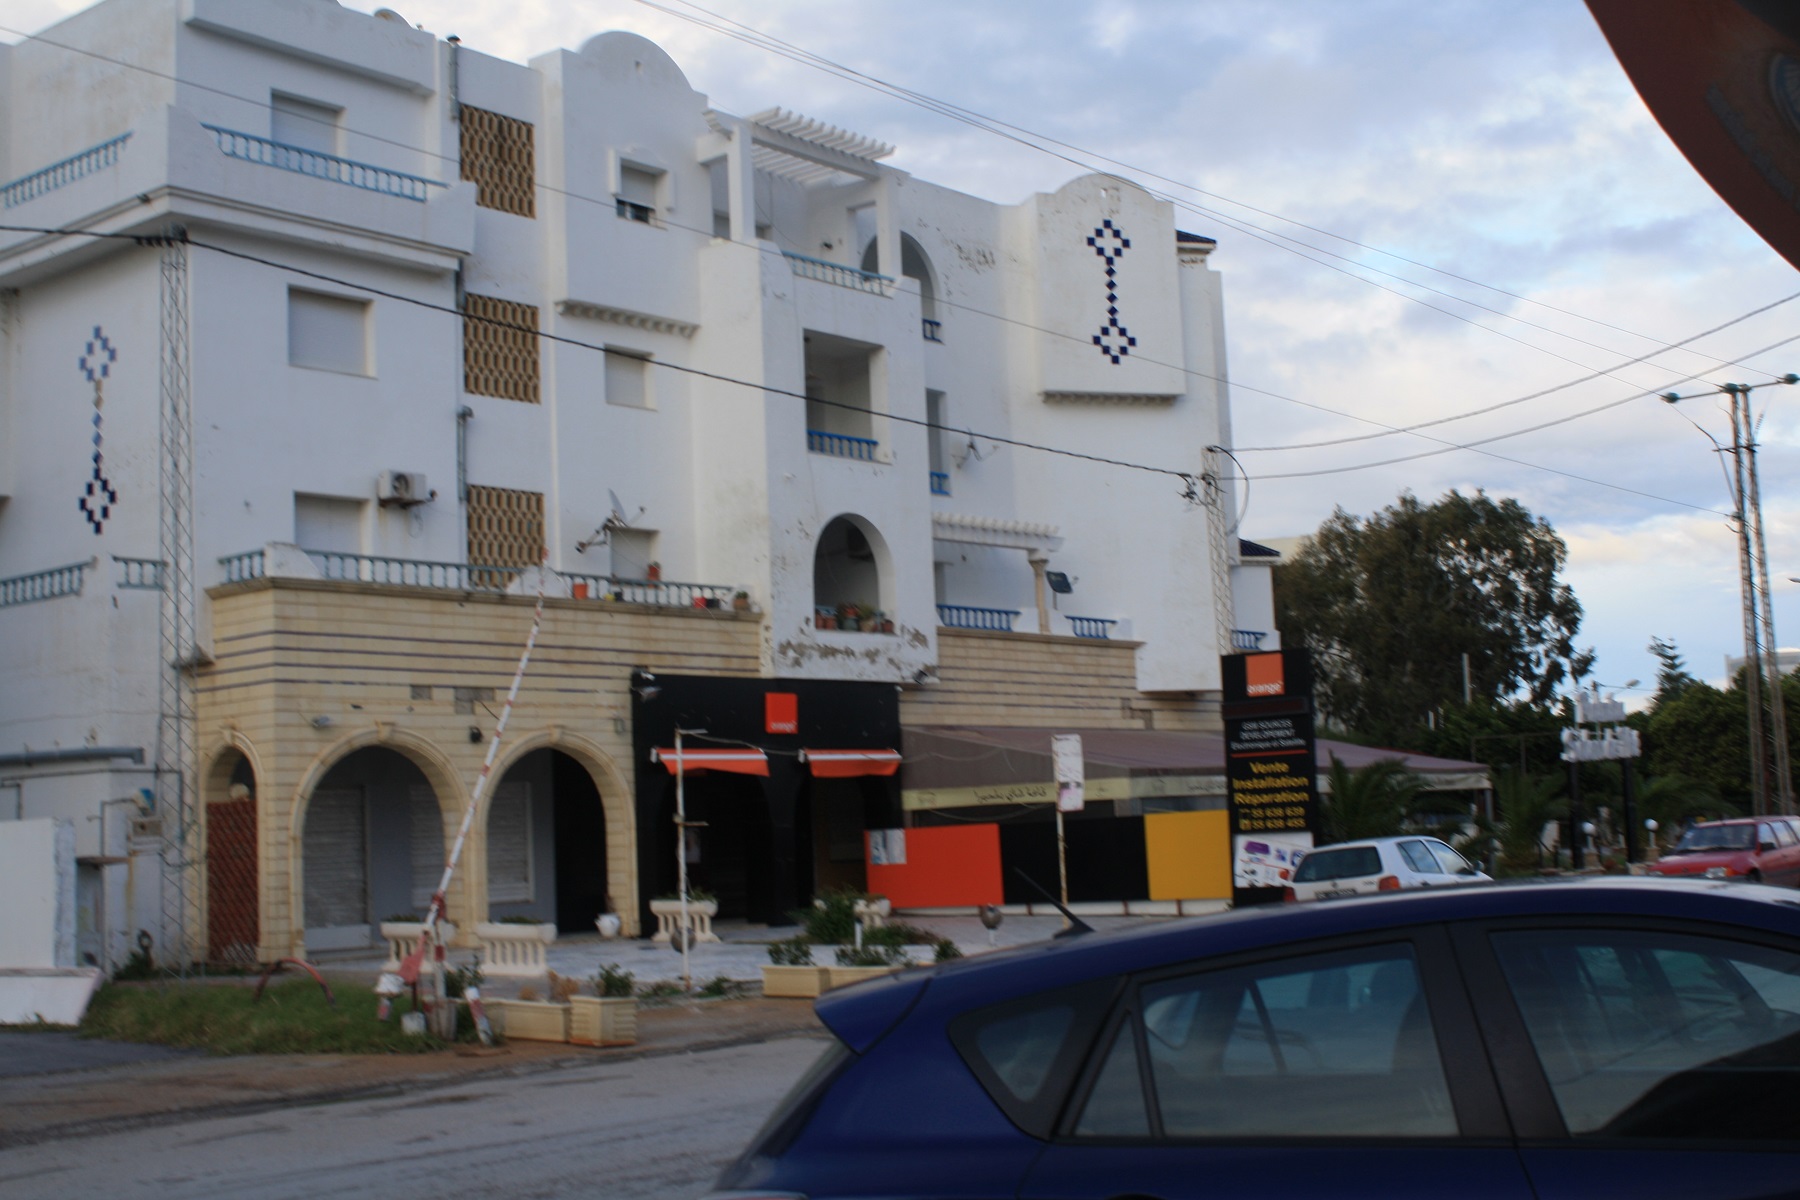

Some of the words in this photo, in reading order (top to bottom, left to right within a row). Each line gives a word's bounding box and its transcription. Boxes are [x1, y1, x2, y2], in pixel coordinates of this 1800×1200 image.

[1247, 682, 1282, 694] orange
[1250, 762, 1289, 773] Vente
[1233, 776, 1308, 788] Installation
[1234, 791, 1308, 805] Réparation
